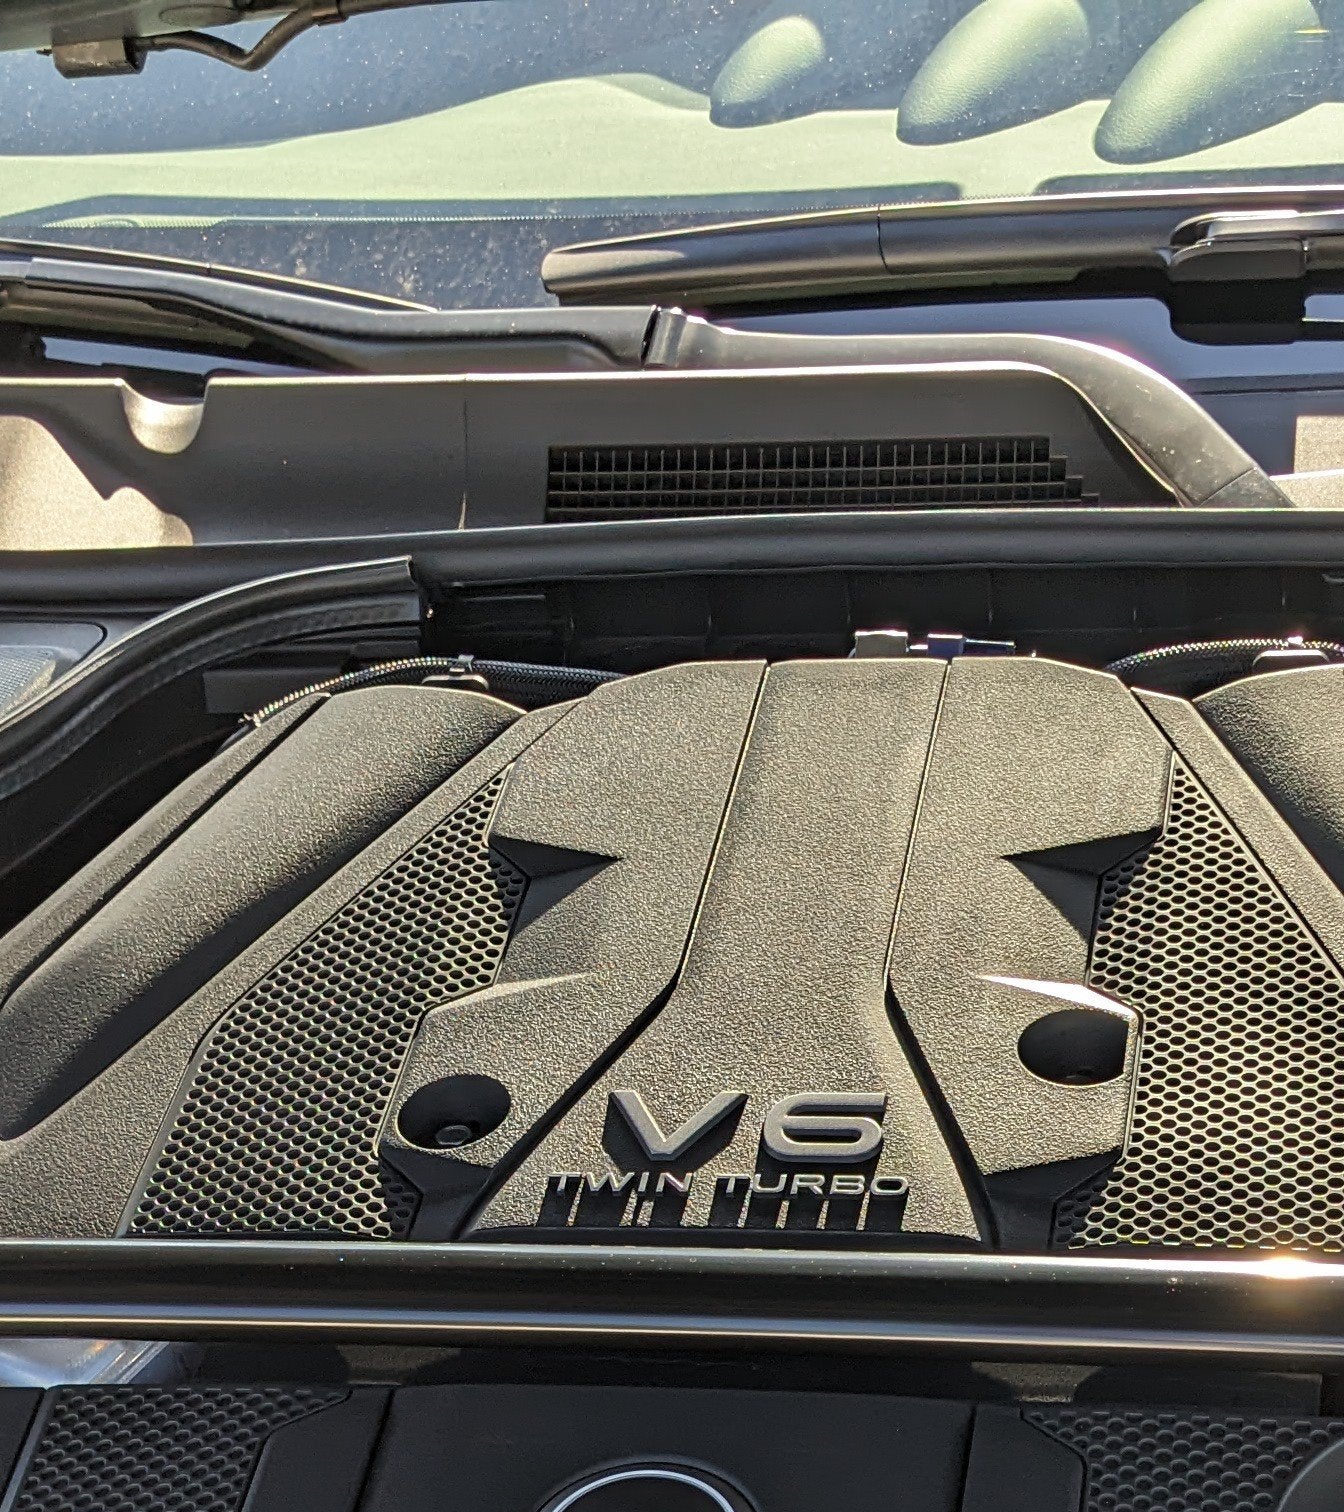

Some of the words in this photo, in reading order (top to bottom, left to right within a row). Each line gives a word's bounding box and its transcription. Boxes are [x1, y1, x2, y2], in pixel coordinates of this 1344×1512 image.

[608, 1090, 889, 1163] V6
[549, 1171, 694, 1198] TWIN
[716, 1172, 910, 1198] TURBO
